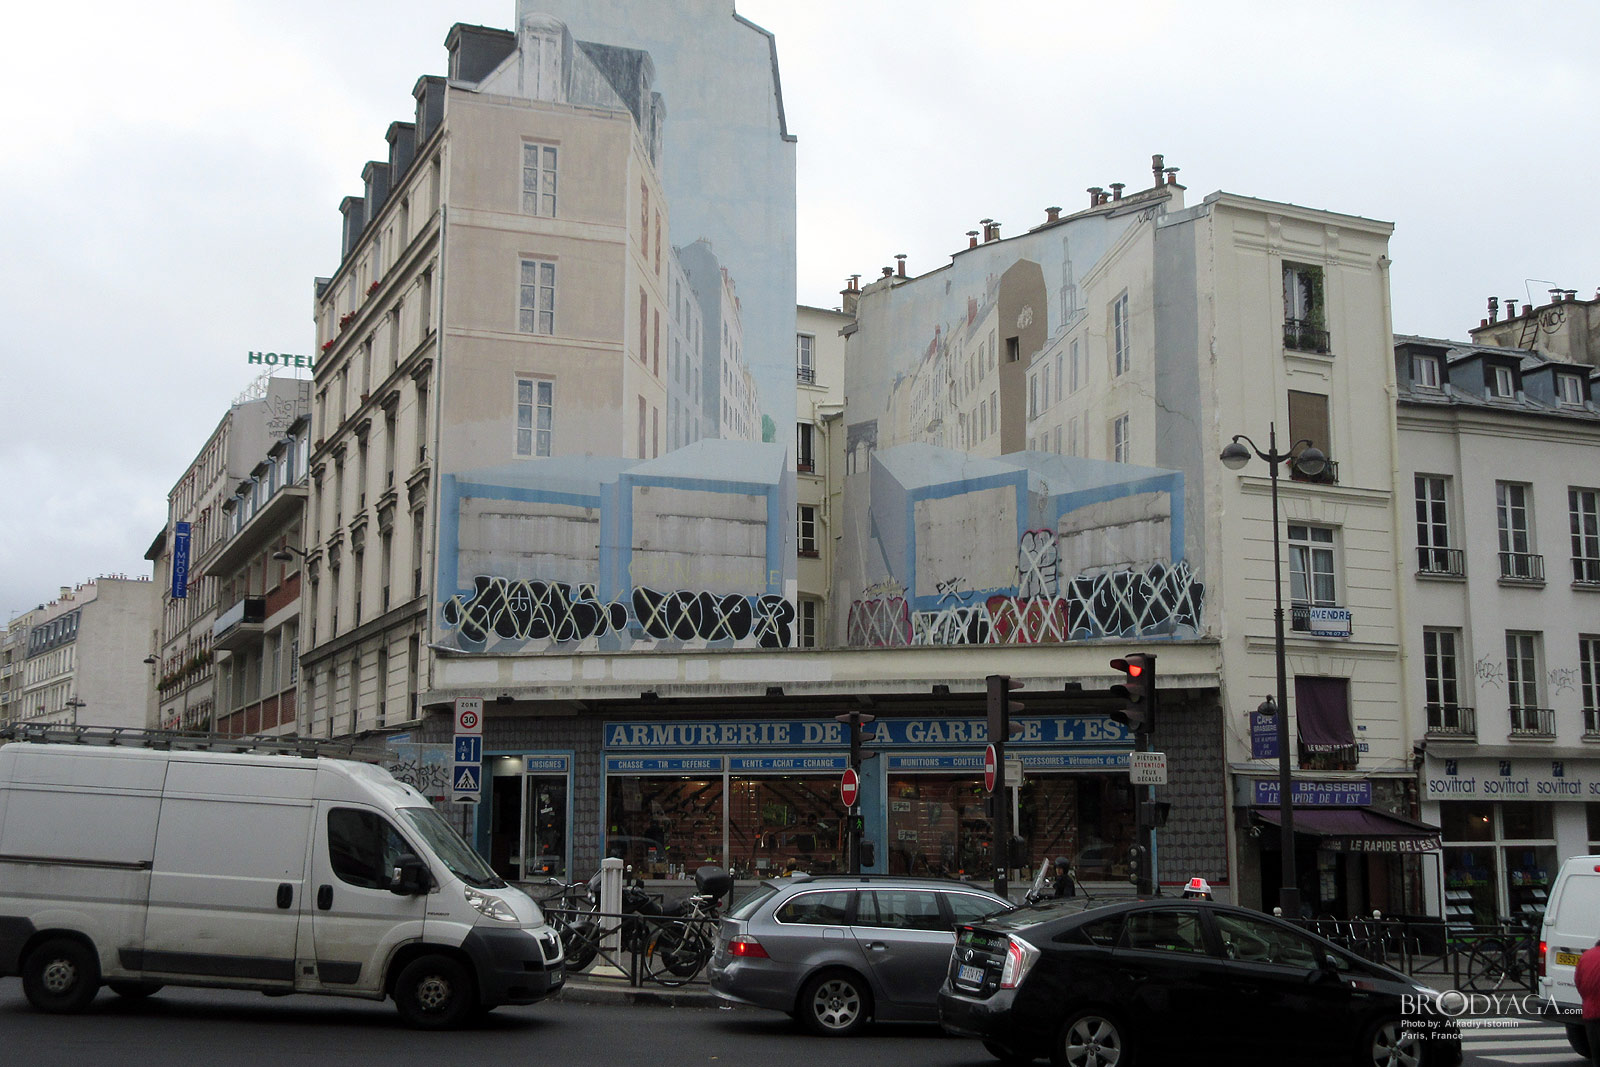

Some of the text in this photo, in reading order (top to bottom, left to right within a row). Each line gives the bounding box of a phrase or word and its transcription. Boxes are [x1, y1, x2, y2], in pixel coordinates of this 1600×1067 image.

[248, 351, 315, 368] HOTEL
[176, 536, 187, 598] TIMHOTEL
[464, 716, 475, 724] 30
[609, 723, 790, 746] ARMURERIE
[802, 722, 842, 744] DE
[905, 721, 988, 743] GARE
[531, 760, 562, 769] INSIGNES
[617, 760, 644, 769] CHASSE
[657, 760, 669, 769] TIR
[681, 759, 711, 769] DEFENSE
[742, 759, 763, 768] VENTE
[772, 759, 794, 768] ACHAT
[803, 758, 835, 768] ECHANGE
[900, 758, 939, 767] MUNITIONS
[1106, 756, 1115, 765] de
[1299, 782, 1367, 792] BRASSERIE
[1429, 777, 1475, 793] sovitrat
[1484, 777, 1529, 794] sovitrat
[1537, 778, 1582, 795] sovitrat
[1268, 793, 1279, 803] LE
[1292, 793, 1314, 804] APIDE
[1318, 793, 1331, 804] DE
[1346, 793, 1360, 804] EST
[1350, 840, 1361, 851] LE
[1363, 841, 1397, 852] RAPIDE
[1399, 841, 1411, 852] DE
[1412, 839, 1439, 851] L'EST
